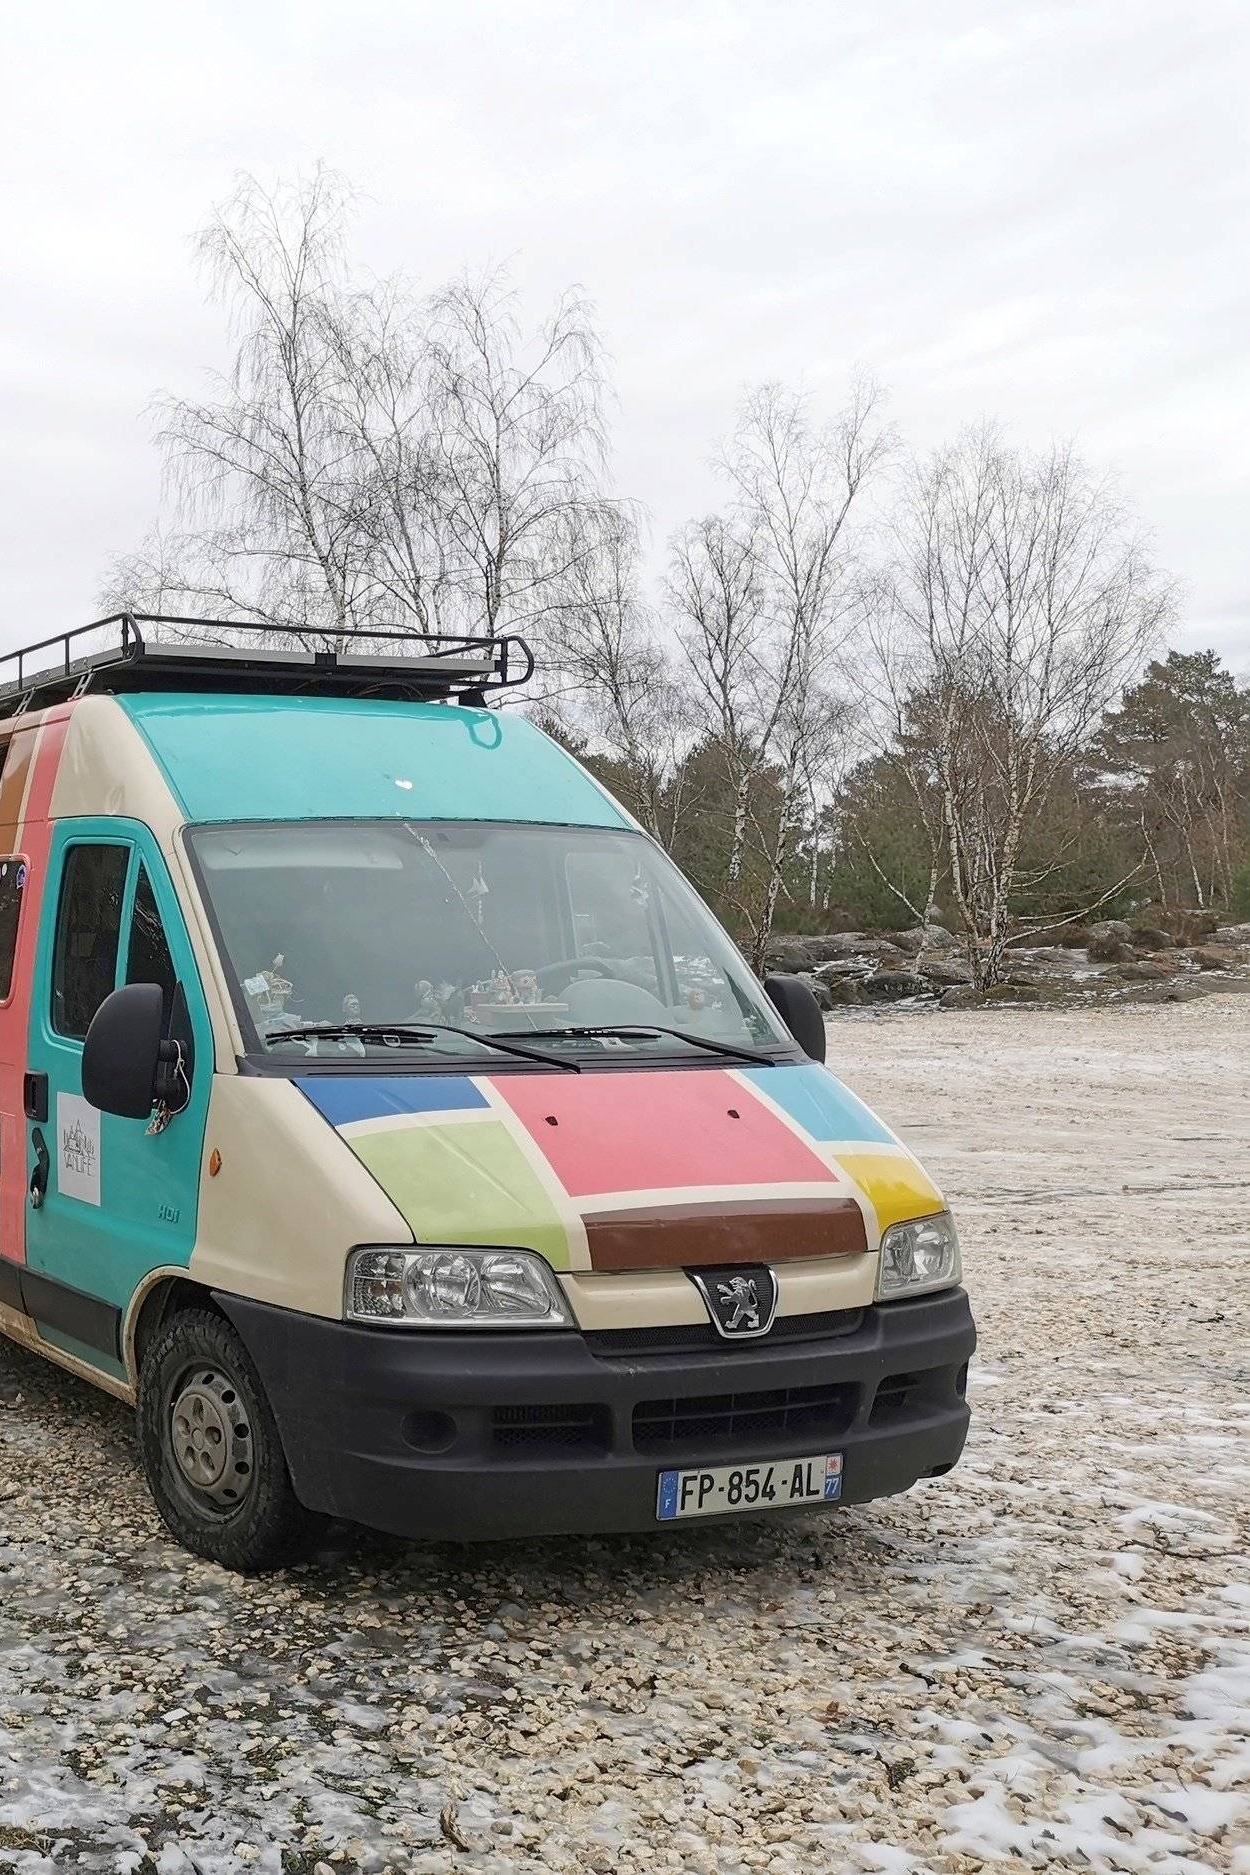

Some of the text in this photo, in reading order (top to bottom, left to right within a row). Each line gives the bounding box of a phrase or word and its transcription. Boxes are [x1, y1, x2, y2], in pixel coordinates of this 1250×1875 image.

[680, 1463, 820, 1511] FP-854-AL
[825, 1477, 840, 1494] 77
[665, 1498, 671, 1509] F
